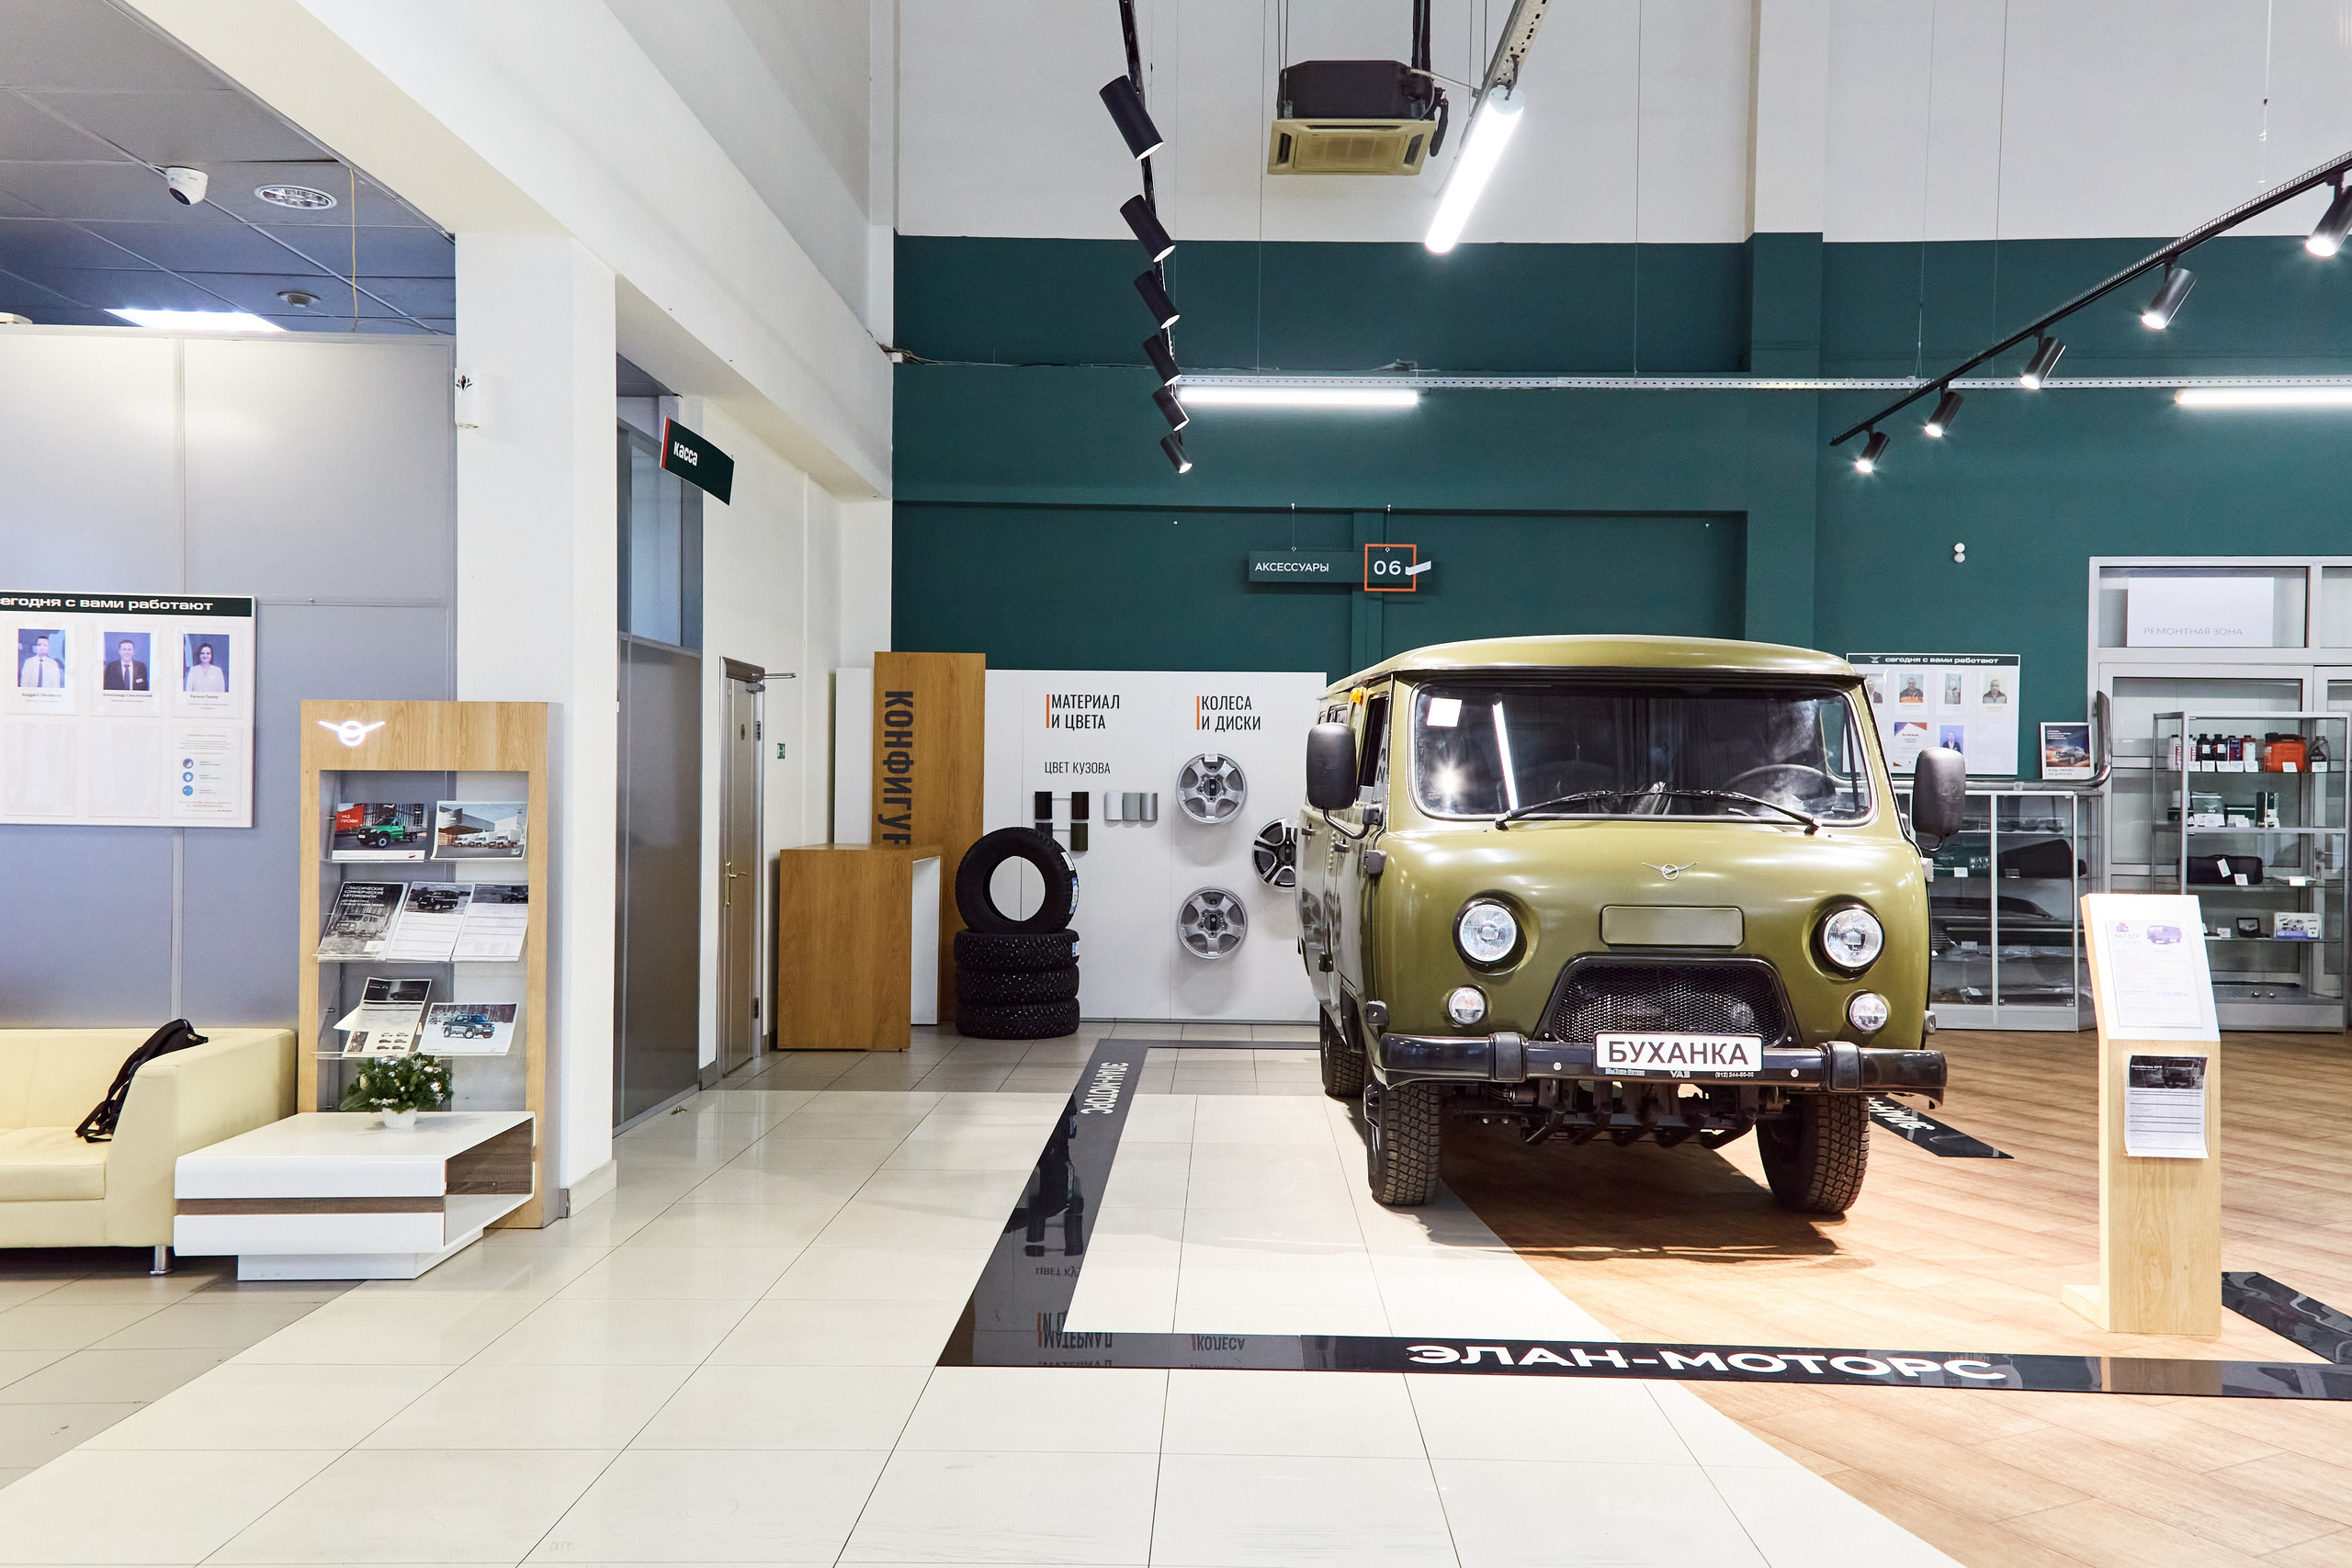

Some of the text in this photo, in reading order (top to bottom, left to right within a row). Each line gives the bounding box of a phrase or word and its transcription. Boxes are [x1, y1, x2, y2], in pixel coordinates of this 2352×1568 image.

[673, 441, 698, 467] касса
[1254, 562, 1329, 572] АКСЕССУАРЫ
[1373, 559, 1402, 576] 06
[0, 597, 213, 611] егодня с вами работают
[2143, 627, 2243, 636] РЕМОНТНАЯ ЗОНА
[1051, 694, 1120, 709] МАТЕРИАЛ
[1201, 695, 1252, 711] КОЛЕСА
[1051, 714, 1106, 731] И ЦВЕТА
[1201, 716, 1261, 733] И ДИСКИ
[1045, 761, 1111, 775] ЦВЕТ КУЗОВА
[1609, 1041, 1749, 1066] БУХАНКА
[1080, 1062, 1129, 1114] ЭЛАН-МОТОРС
[1406, 1345, 2007, 1381] ЭЛАН-МОТОРС
